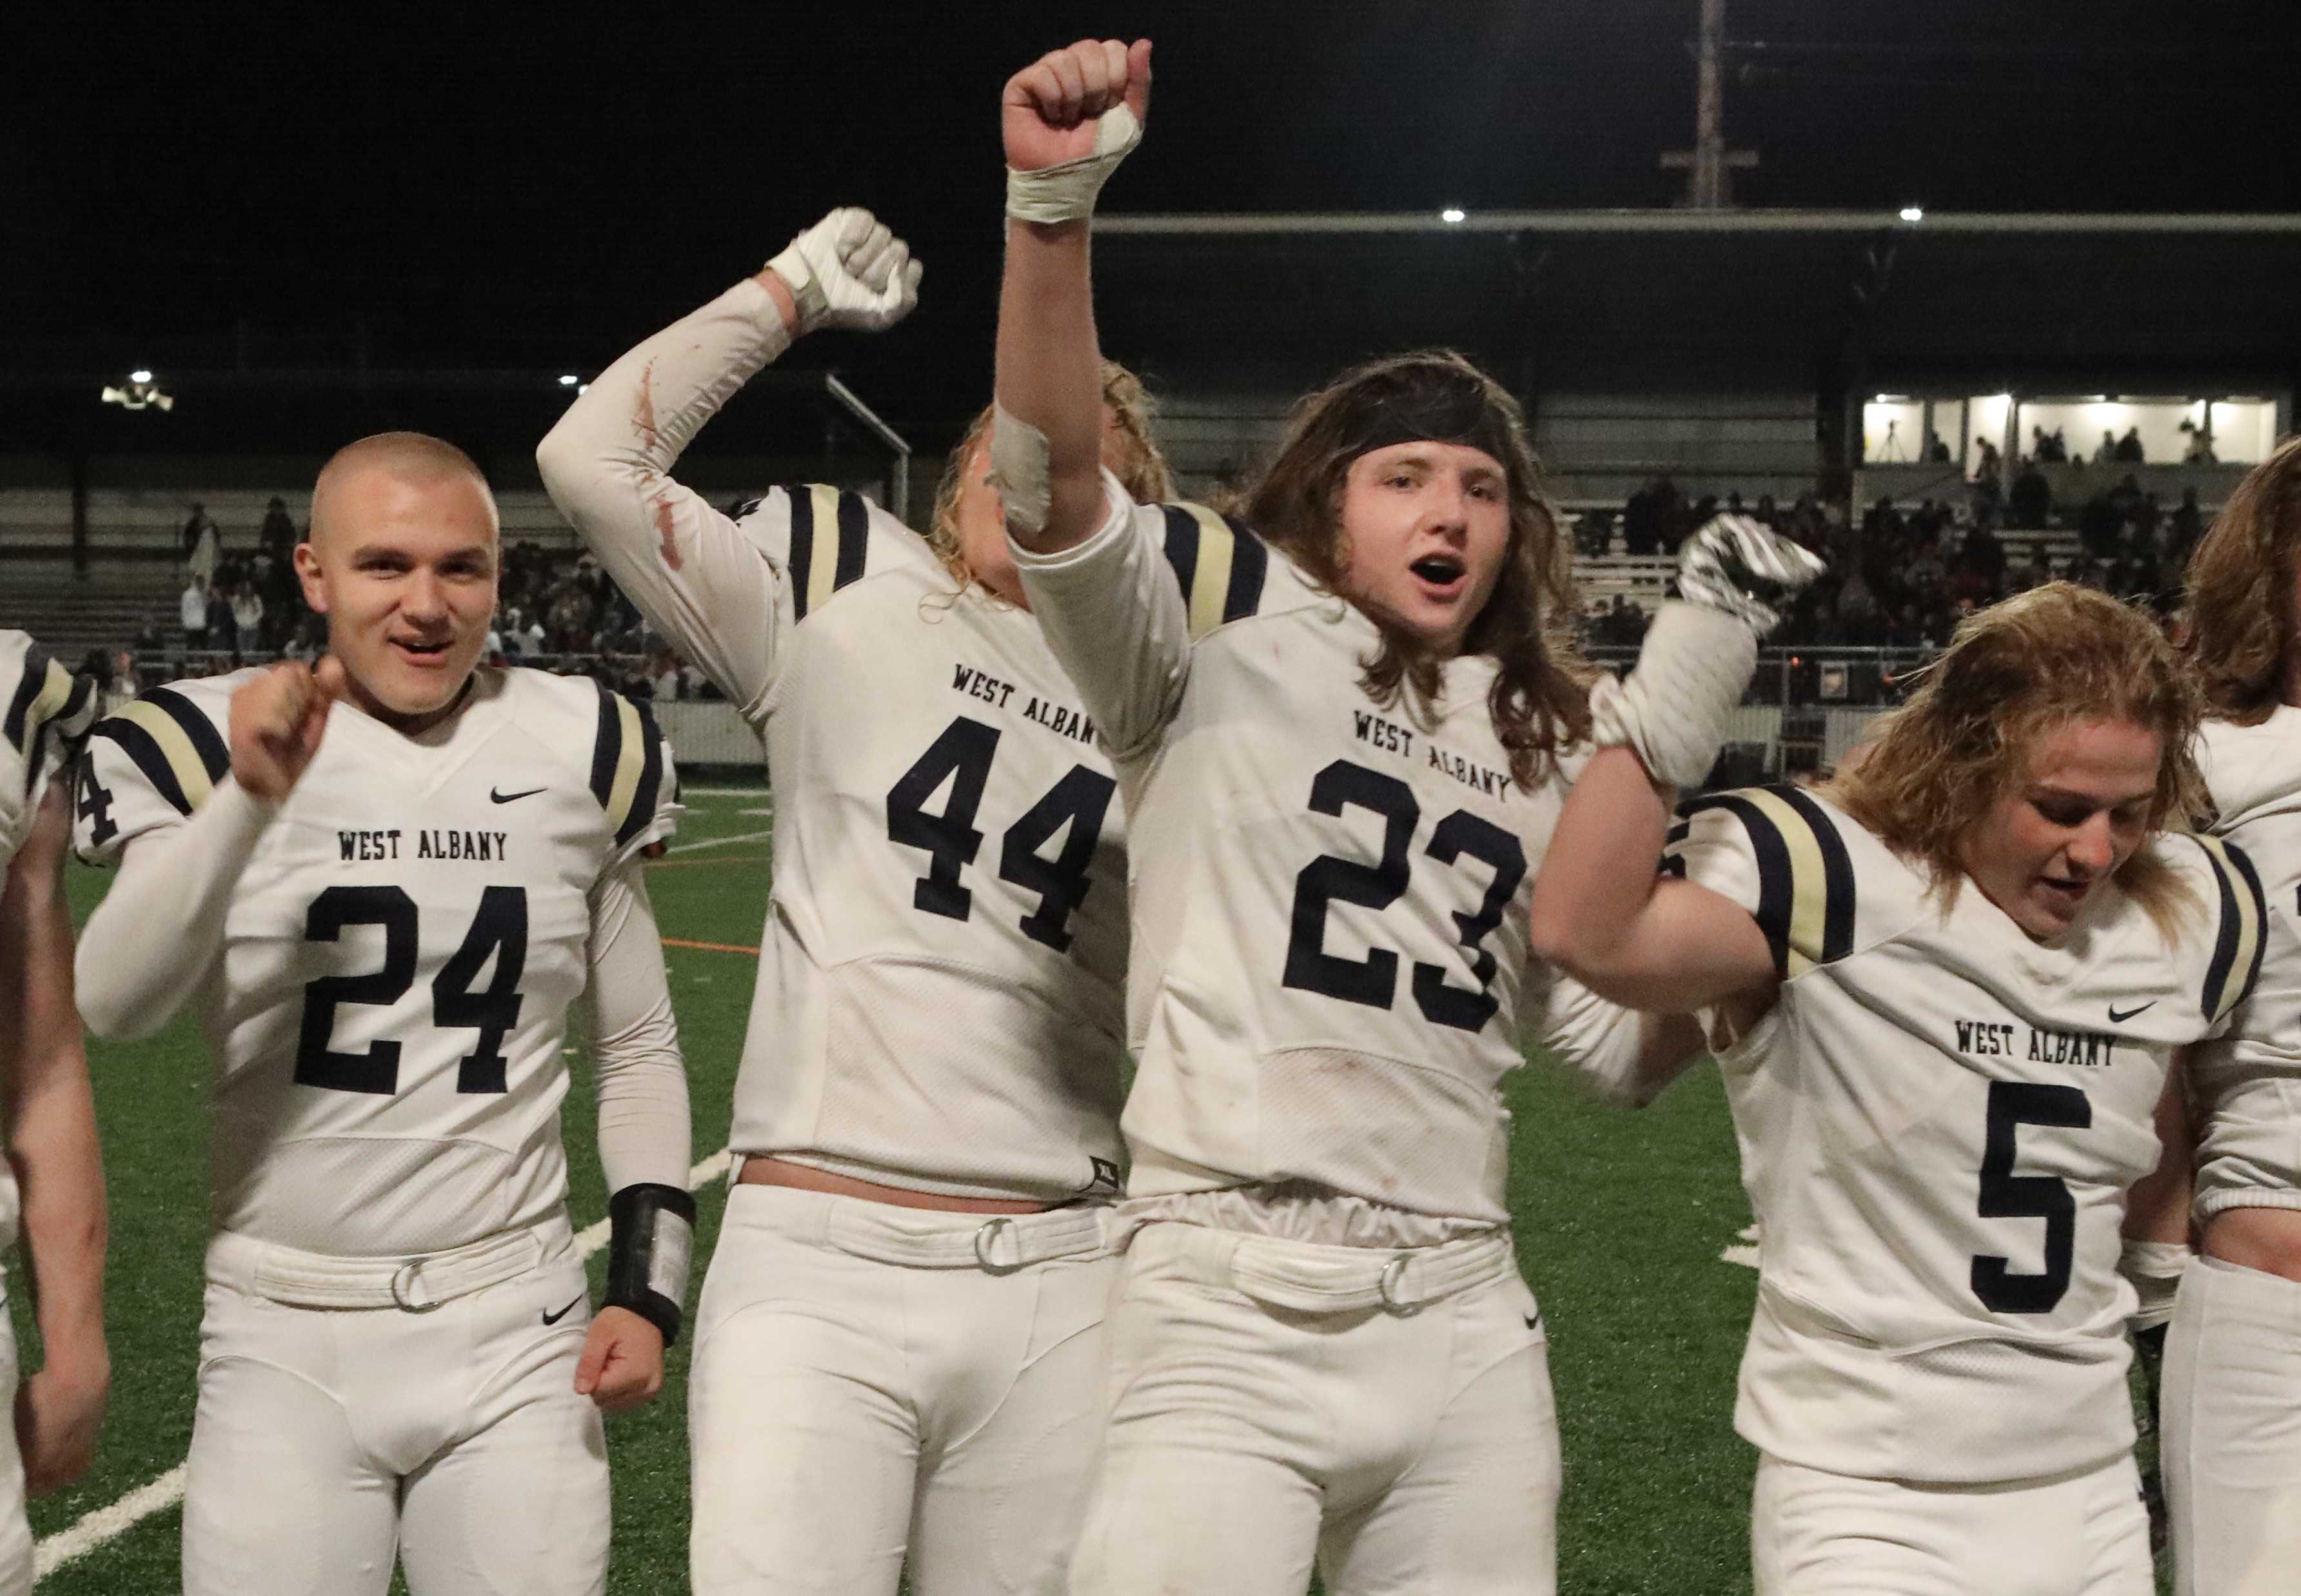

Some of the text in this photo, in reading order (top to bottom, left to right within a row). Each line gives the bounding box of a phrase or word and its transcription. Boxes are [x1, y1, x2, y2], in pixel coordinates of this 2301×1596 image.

[952, 664, 1096, 744] WEST ALBAN
[1354, 710, 1512, 803] WEST ALBANY
[337, 829, 508, 861] WEST ALBANY
[886, 715, 1118, 953] 44
[1282, 758, 1527, 1034] 23
[294, 885, 529, 1095] 24
[1955, 1020, 2117, 1067] WEST ALBANY
[1971, 1081, 2092, 1314] 5
